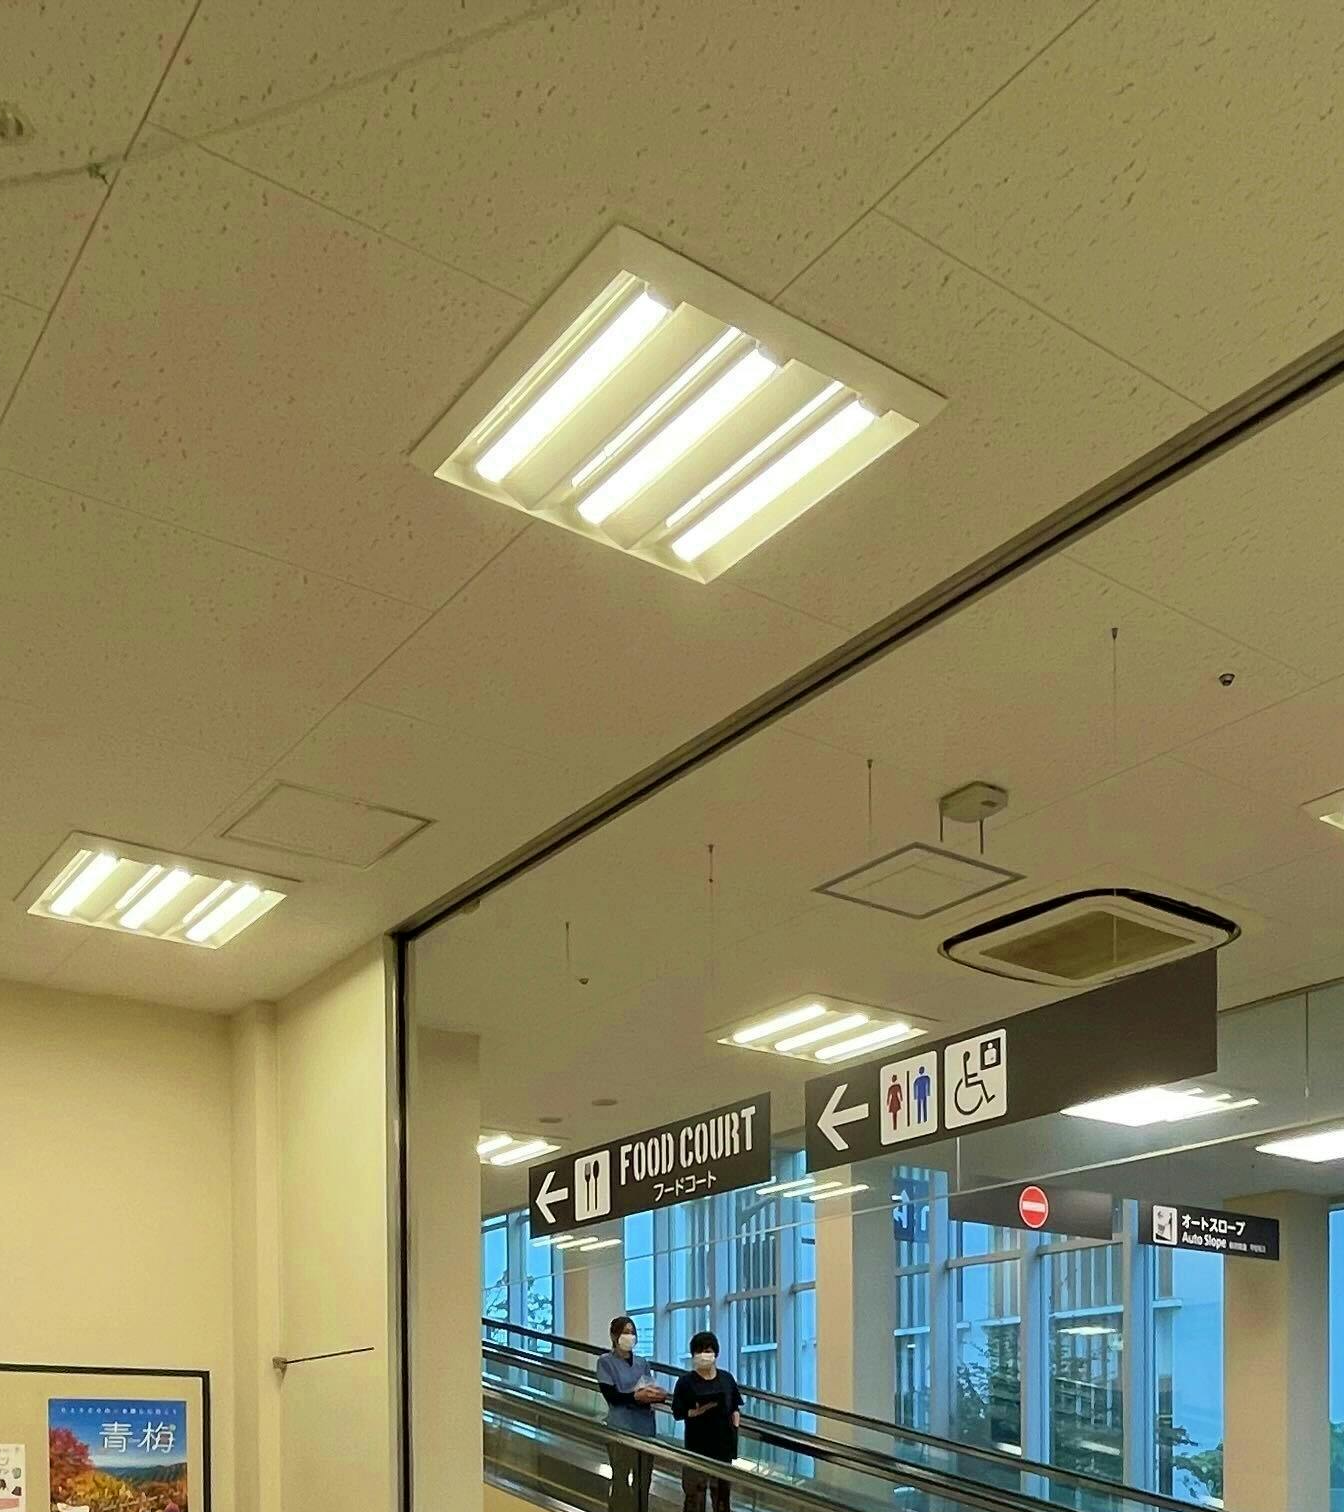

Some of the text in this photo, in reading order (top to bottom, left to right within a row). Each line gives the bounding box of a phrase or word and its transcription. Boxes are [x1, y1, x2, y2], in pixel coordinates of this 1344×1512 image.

[620, 1105, 757, 1186] FOOD COURT
[653, 1170, 717, 1202] フードコート
[1181, 1213, 1246, 1236] オートスロープ
[1181, 1231, 1203, 1246] Auto
[1204, 1234, 1227, 1250] Slope
[99, 1421, 176, 1453] 青梅
